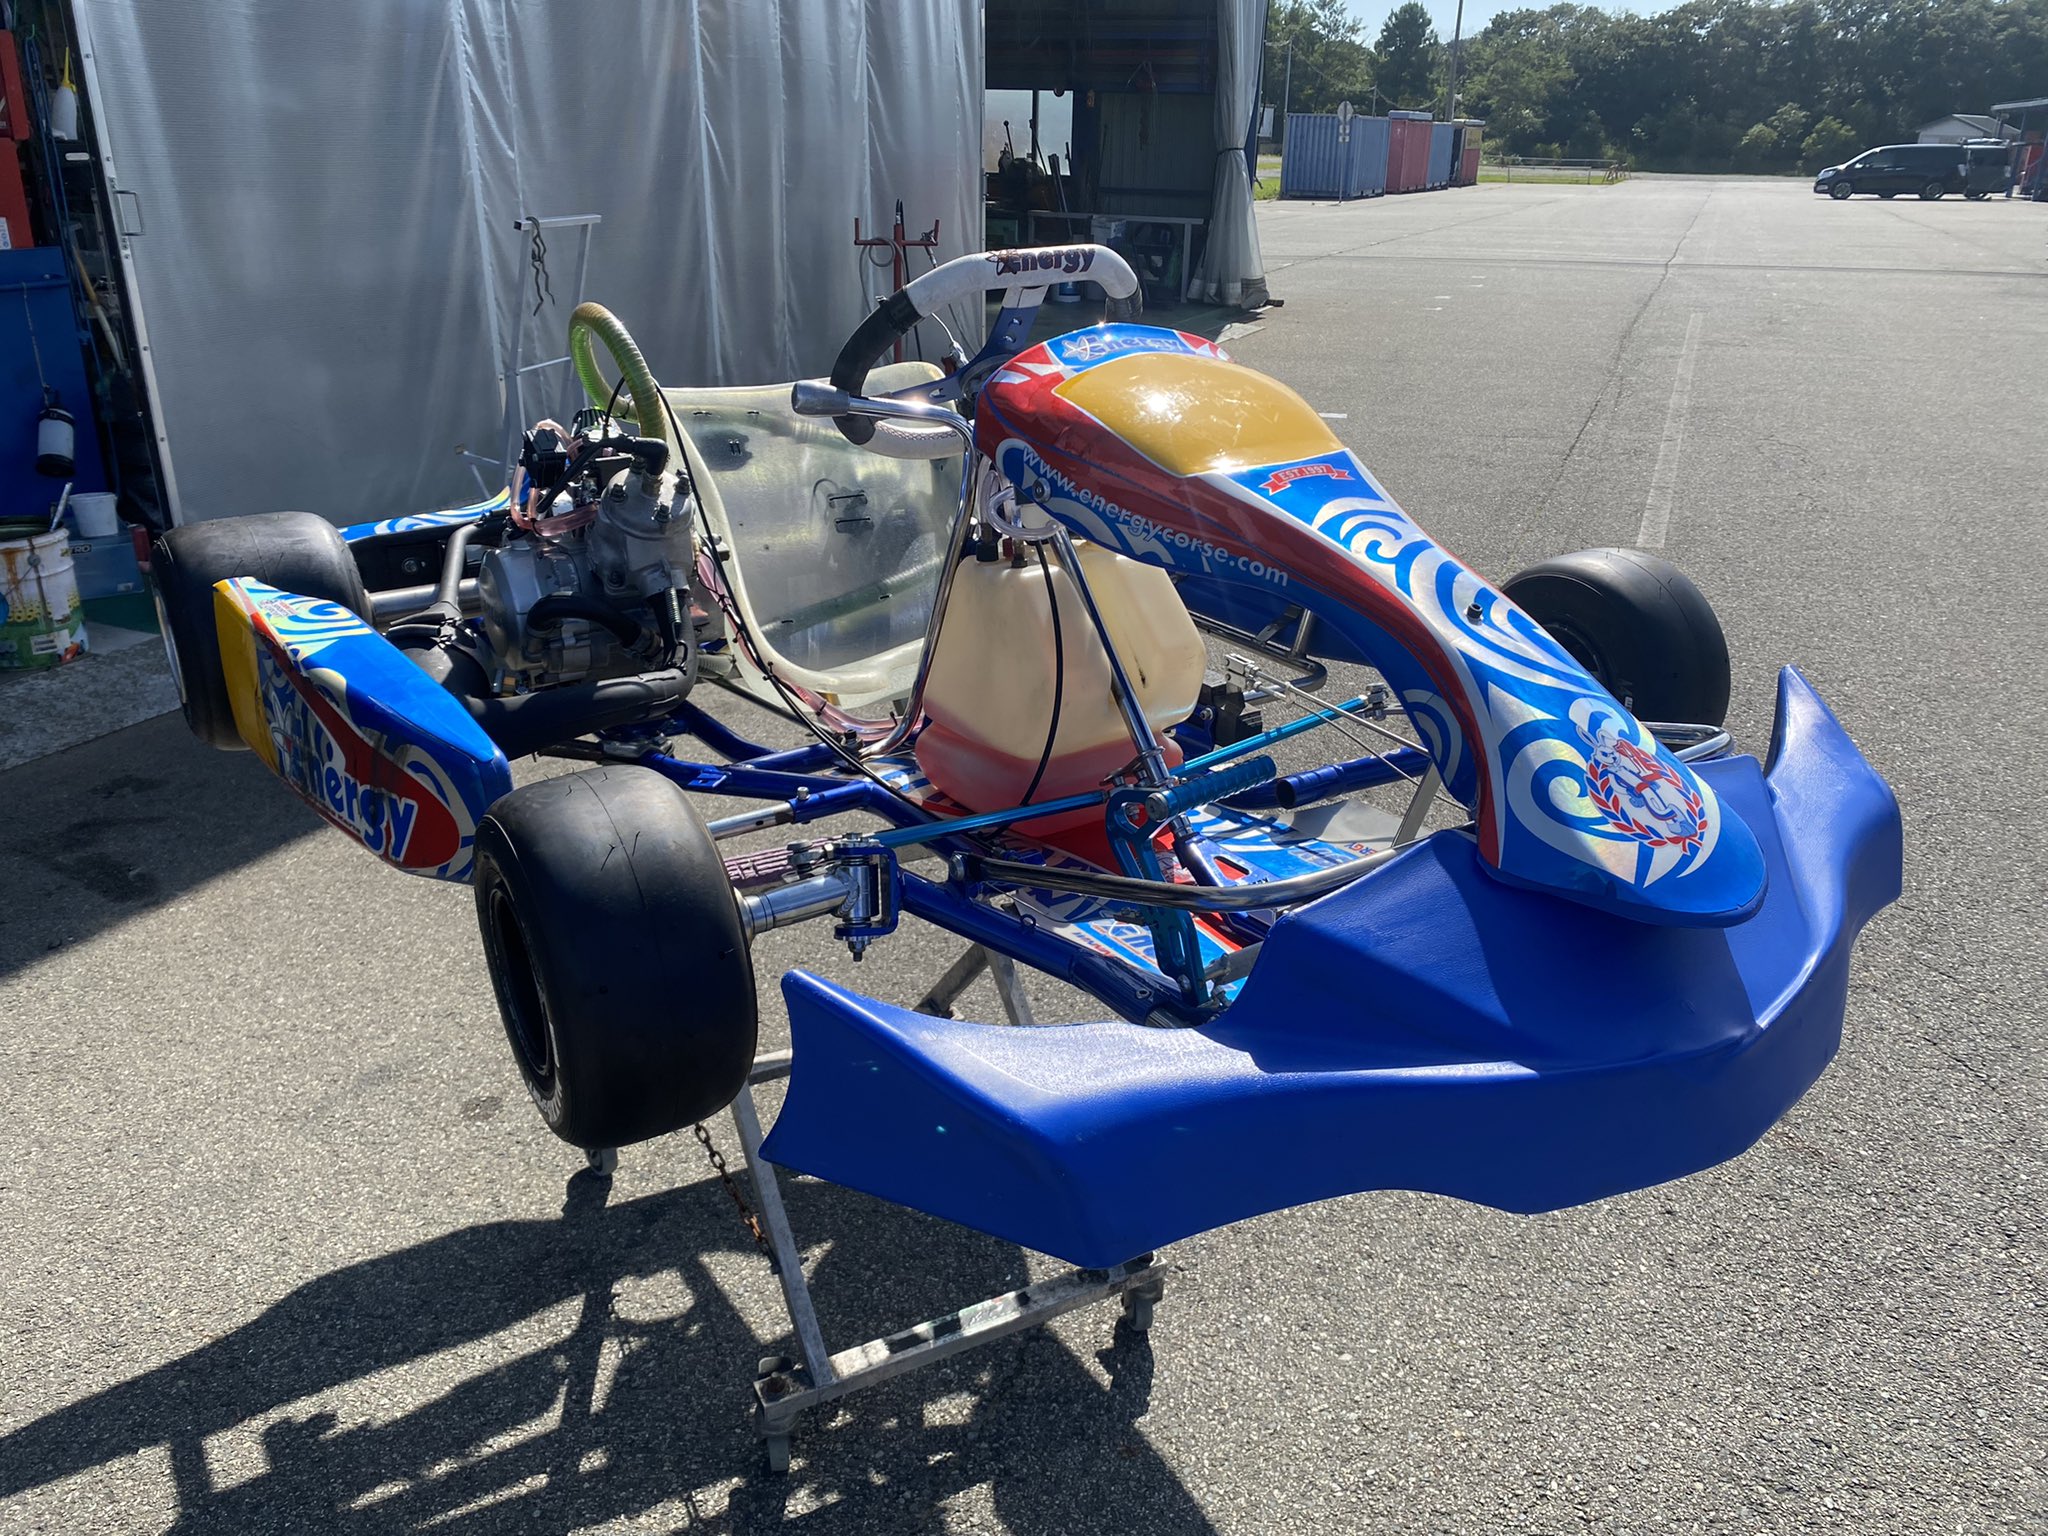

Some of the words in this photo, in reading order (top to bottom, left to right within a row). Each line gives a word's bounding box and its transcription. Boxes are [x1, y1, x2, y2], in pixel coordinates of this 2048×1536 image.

[1279, 468, 1301, 480] EST
[1303, 465, 1327, 475] 1997
[1023, 447, 1289, 587] www.energycorse.com
